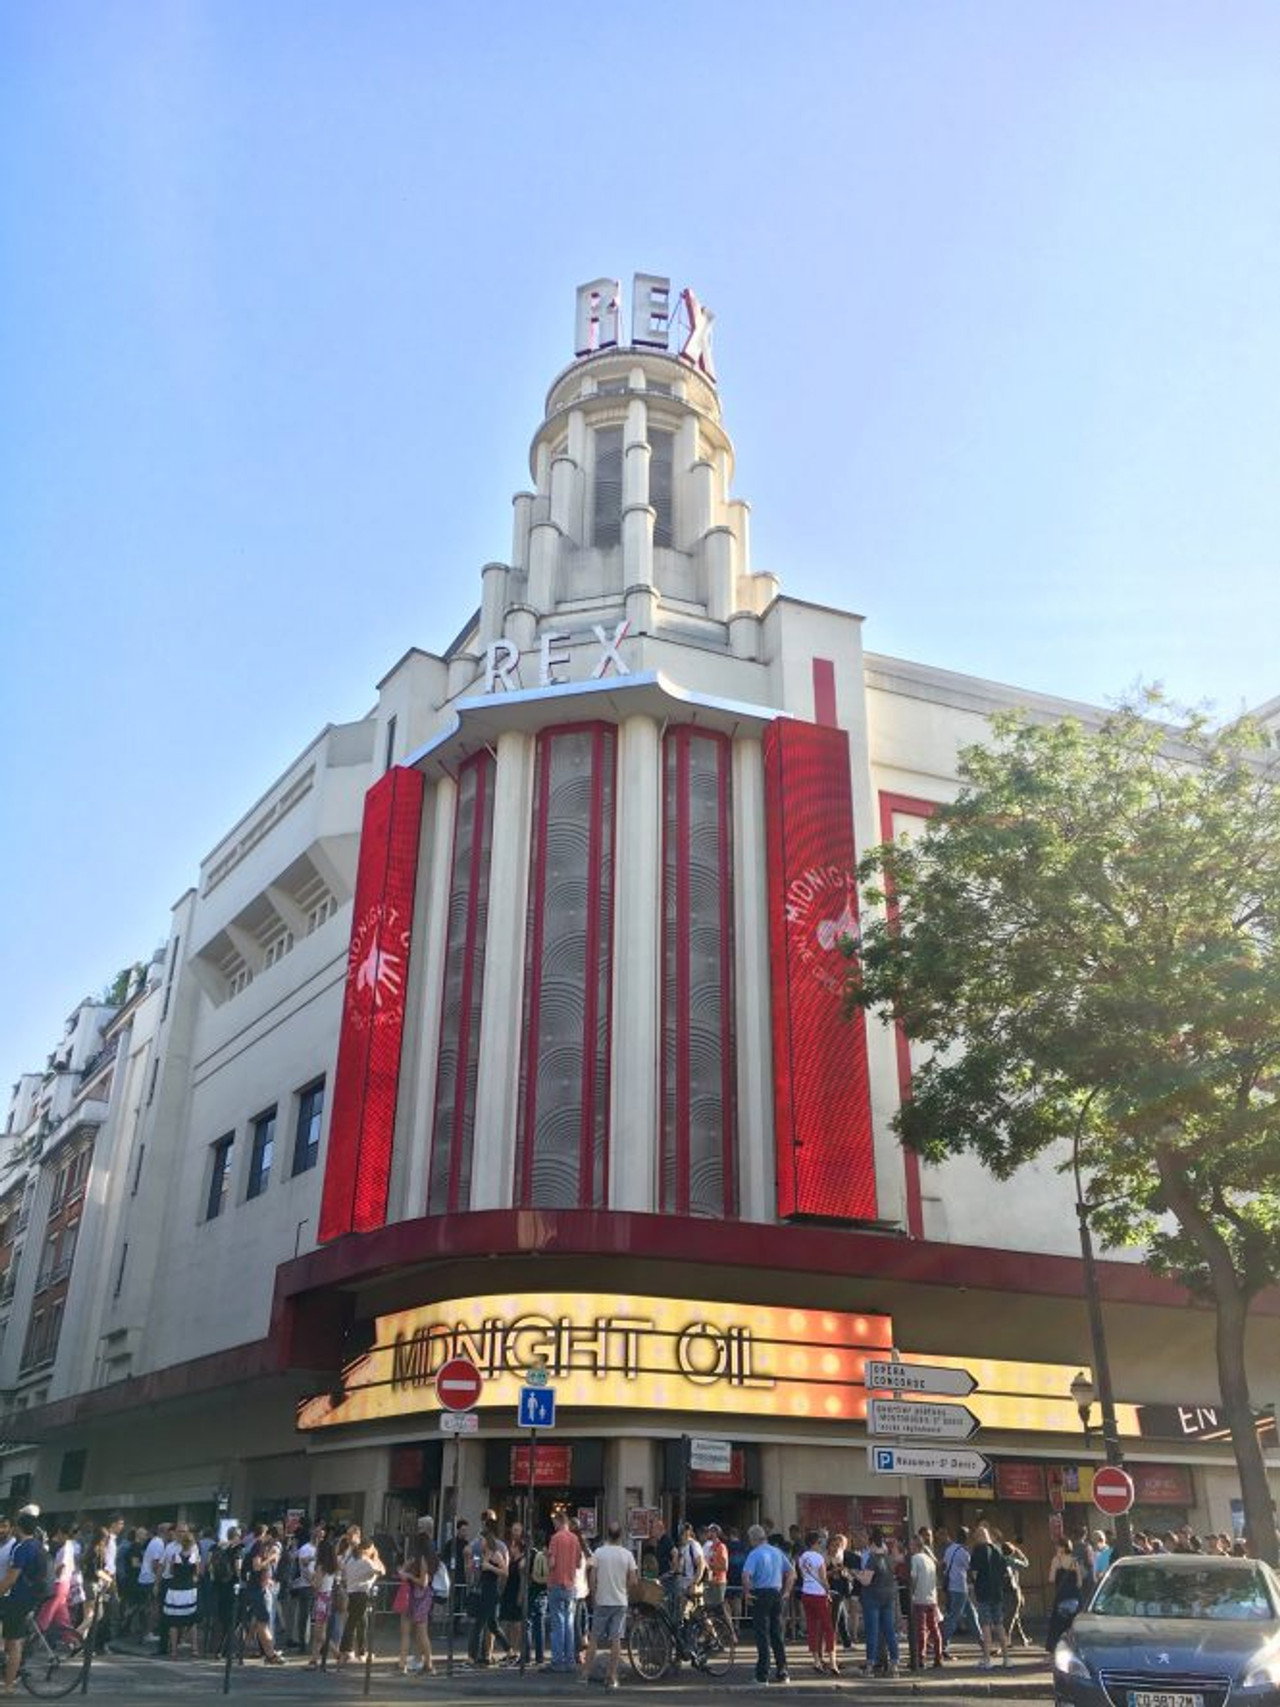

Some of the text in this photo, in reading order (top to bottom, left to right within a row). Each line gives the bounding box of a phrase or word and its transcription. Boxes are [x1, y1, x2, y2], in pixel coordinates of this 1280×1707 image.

[574, 272, 717, 383] REX
[484, 618, 632, 693] REX
[391, 1313, 777, 1391] MIDNIGHT OIL
